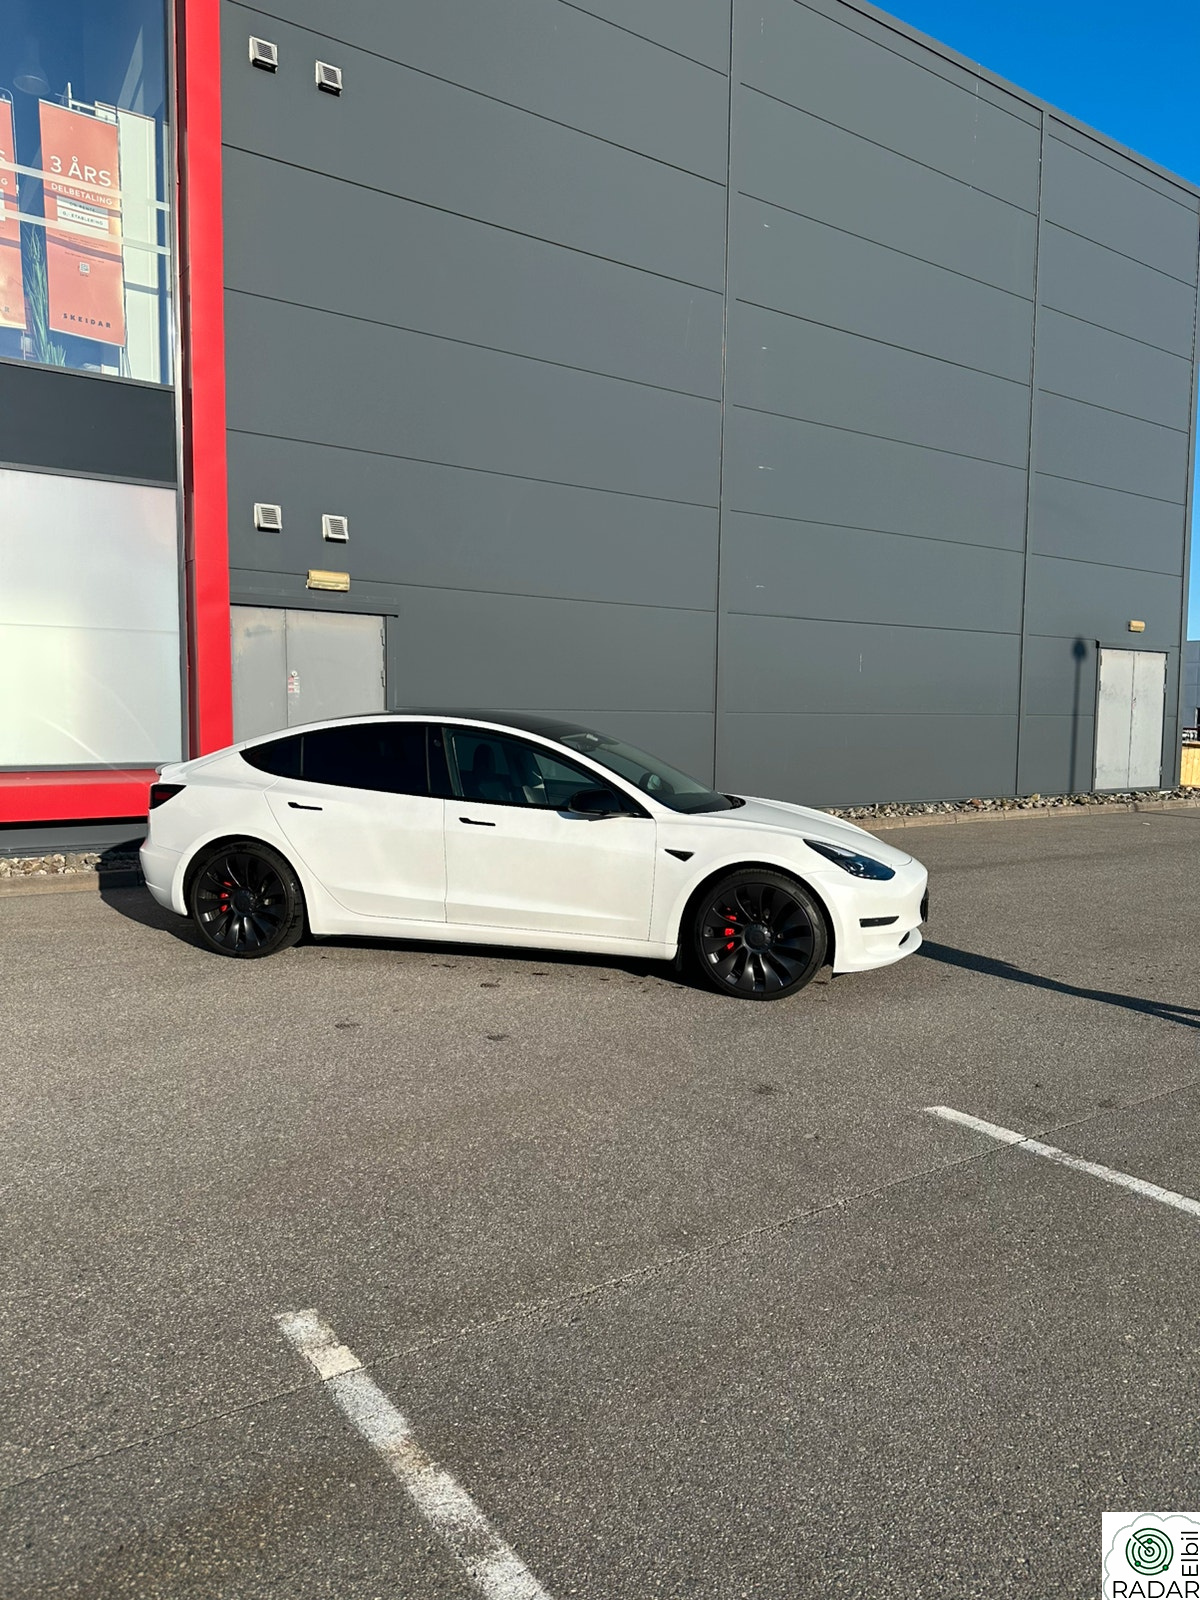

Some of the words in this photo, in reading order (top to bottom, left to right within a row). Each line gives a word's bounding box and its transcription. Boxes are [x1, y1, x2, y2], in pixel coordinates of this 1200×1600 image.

[50, 155, 62, 173] 3
[68, 156, 112, 187] ÅRS
[51, 182, 113, 205] DELBETALING
[63, 312, 111, 328] SKEIDAR
